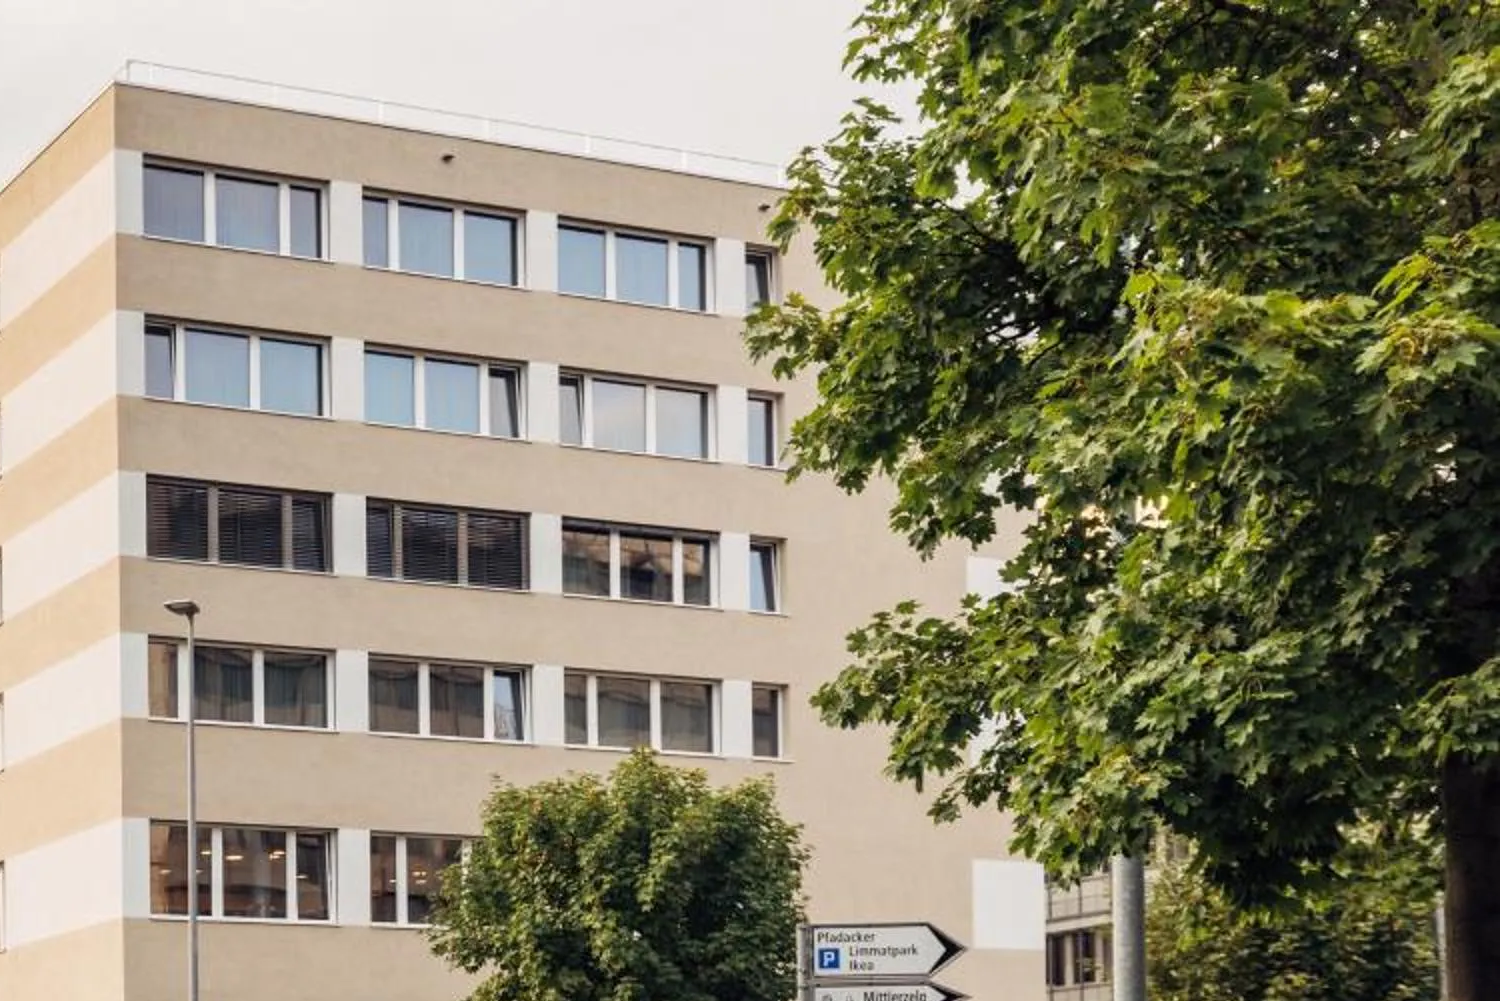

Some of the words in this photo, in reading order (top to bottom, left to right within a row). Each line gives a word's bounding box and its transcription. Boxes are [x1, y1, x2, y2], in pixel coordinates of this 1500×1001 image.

[817, 932, 876, 943] Pfadacker
[849, 944, 918, 957] Limmatpark
[822, 951, 836, 967] P
[849, 960, 875, 971] Ikea
